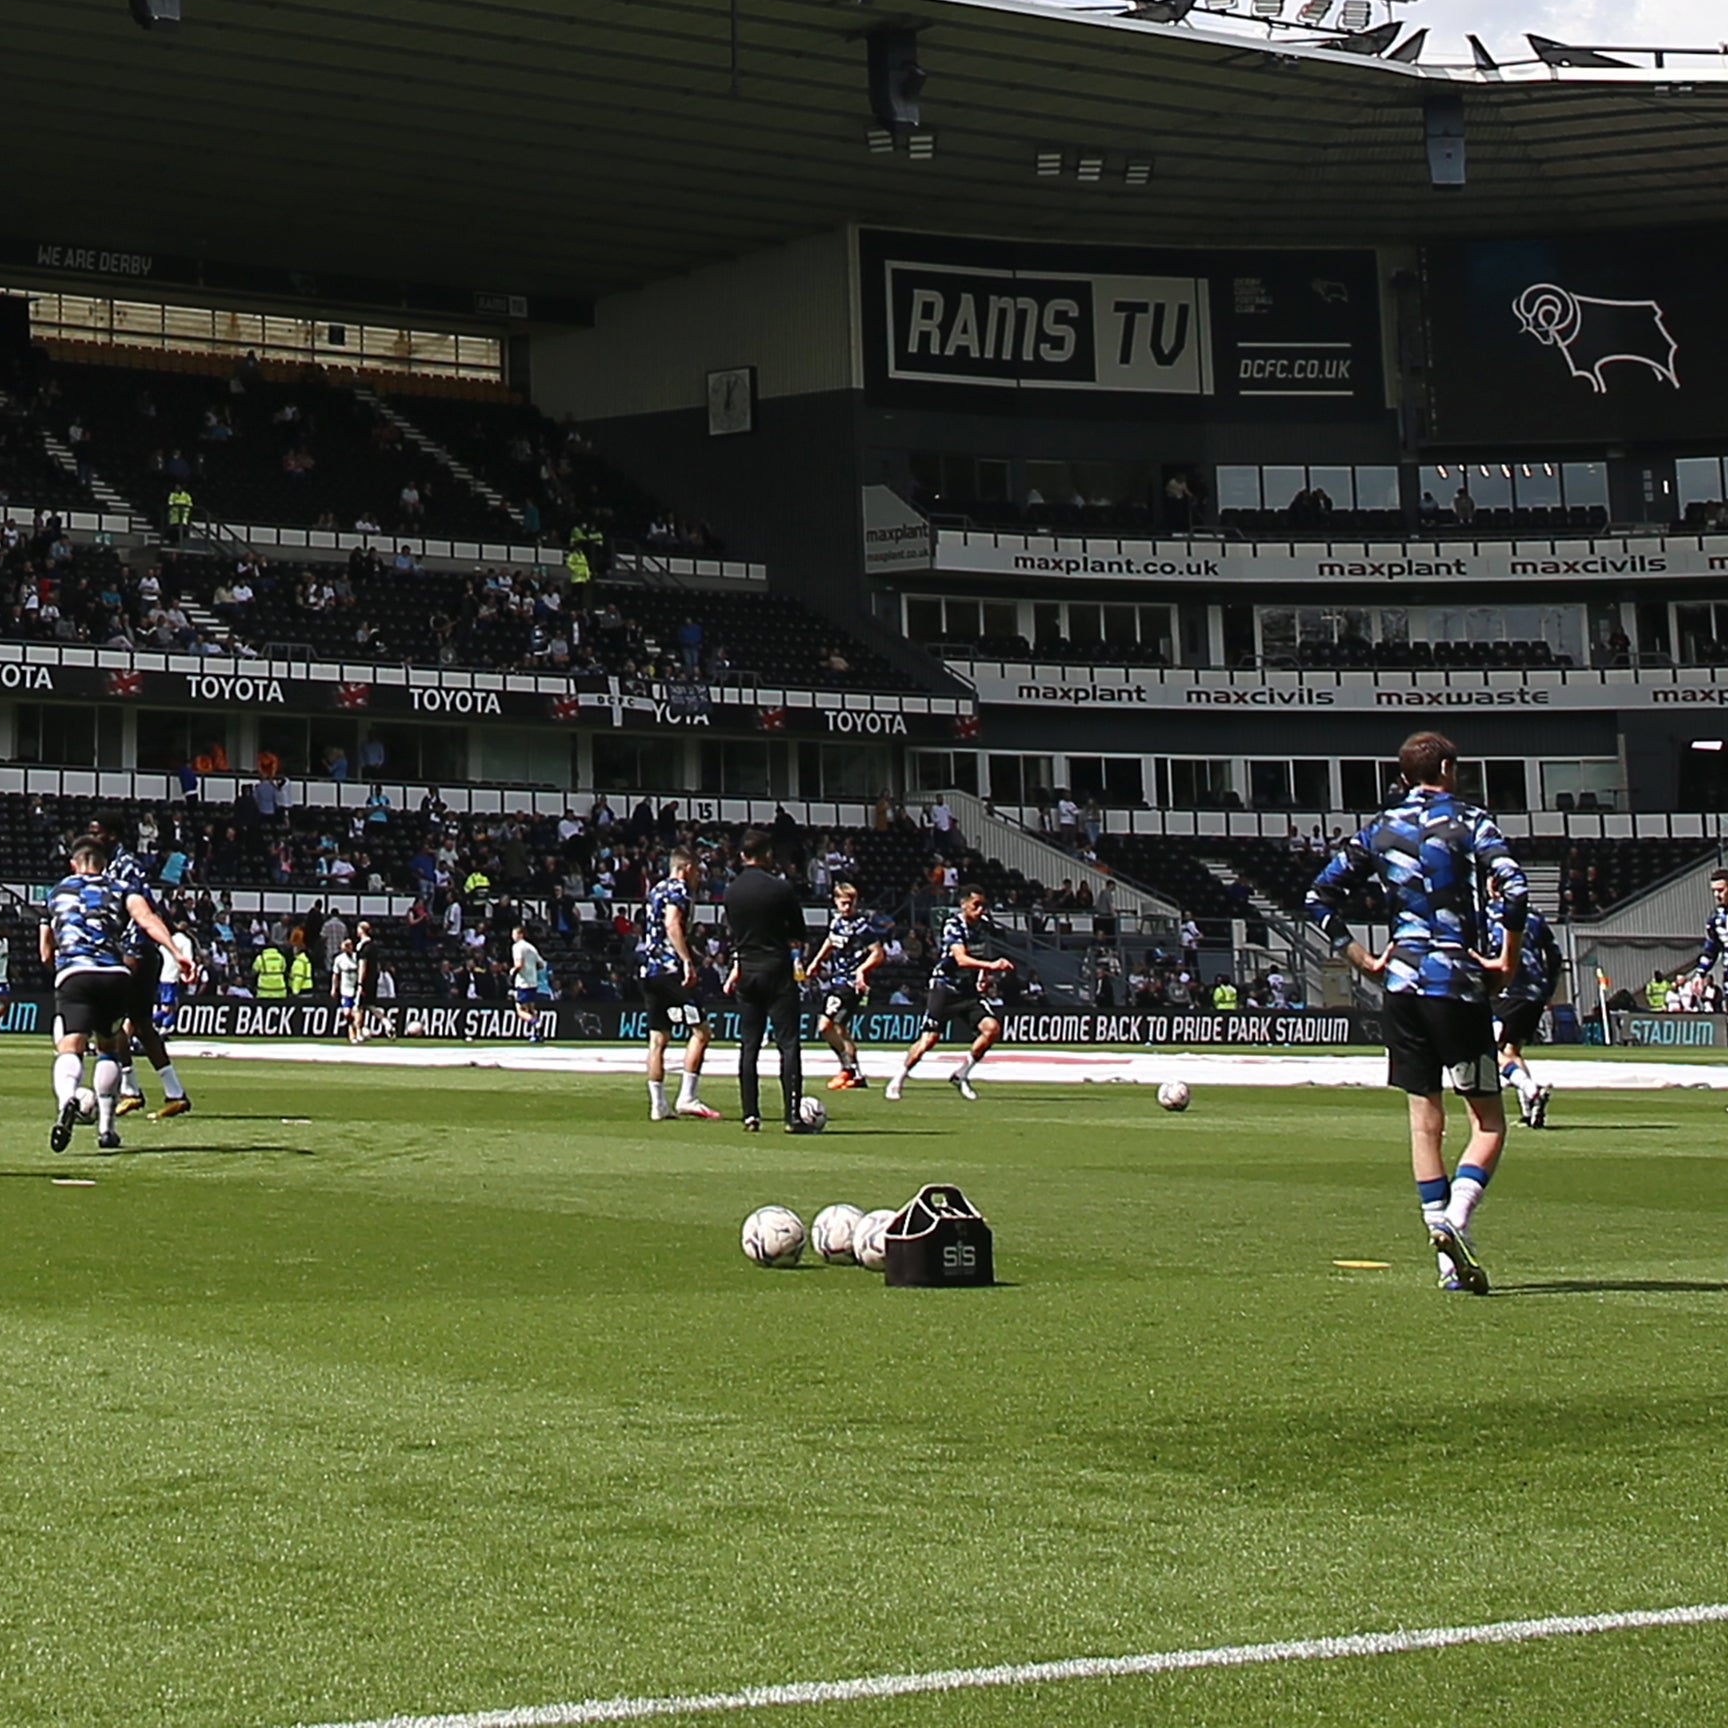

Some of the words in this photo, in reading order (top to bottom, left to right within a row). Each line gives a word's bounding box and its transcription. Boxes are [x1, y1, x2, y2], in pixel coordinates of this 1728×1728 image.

[37, 245, 62, 267] WE
[64, 249, 96, 270] ARE
[99, 251, 153, 277] DERBY
[906, 287, 1080, 363] RAMS
[1112, 300, 1190, 367] TV
[1239, 358, 1351, 379] DCFC.CO.UK
[867, 524, 929, 547] maxplant
[1014, 553, 1219, 576] maxplant.co.uk
[1318, 558, 1467, 579] maxplant
[1510, 553, 1668, 574] maxcivils
[186, 675, 285, 703] TOYOTA
[409, 688, 502, 714] TOYOTA
[1018, 683, 1147, 704] maxplant
[1186, 687, 1336, 705] maxcivils
[1376, 687, 1550, 706] maxwaste
[824, 710, 908, 735] TOYOTA
[696, 803, 712, 821] 15
[234, 1006, 296, 1036] BACK
[301, 1007, 329, 1035] TO
[1003, 1015, 1090, 1041] WELCOME
[1095, 1015, 1141, 1041] BACK
[1146, 1015, 1167, 1041] TO
[1172, 1016, 1222, 1042] PRIDE
[1226, 1016, 1271, 1042] PARK
[1275, 1016, 1349, 1043] STADIUM
[1630, 1021, 1714, 1045] STADIUM
